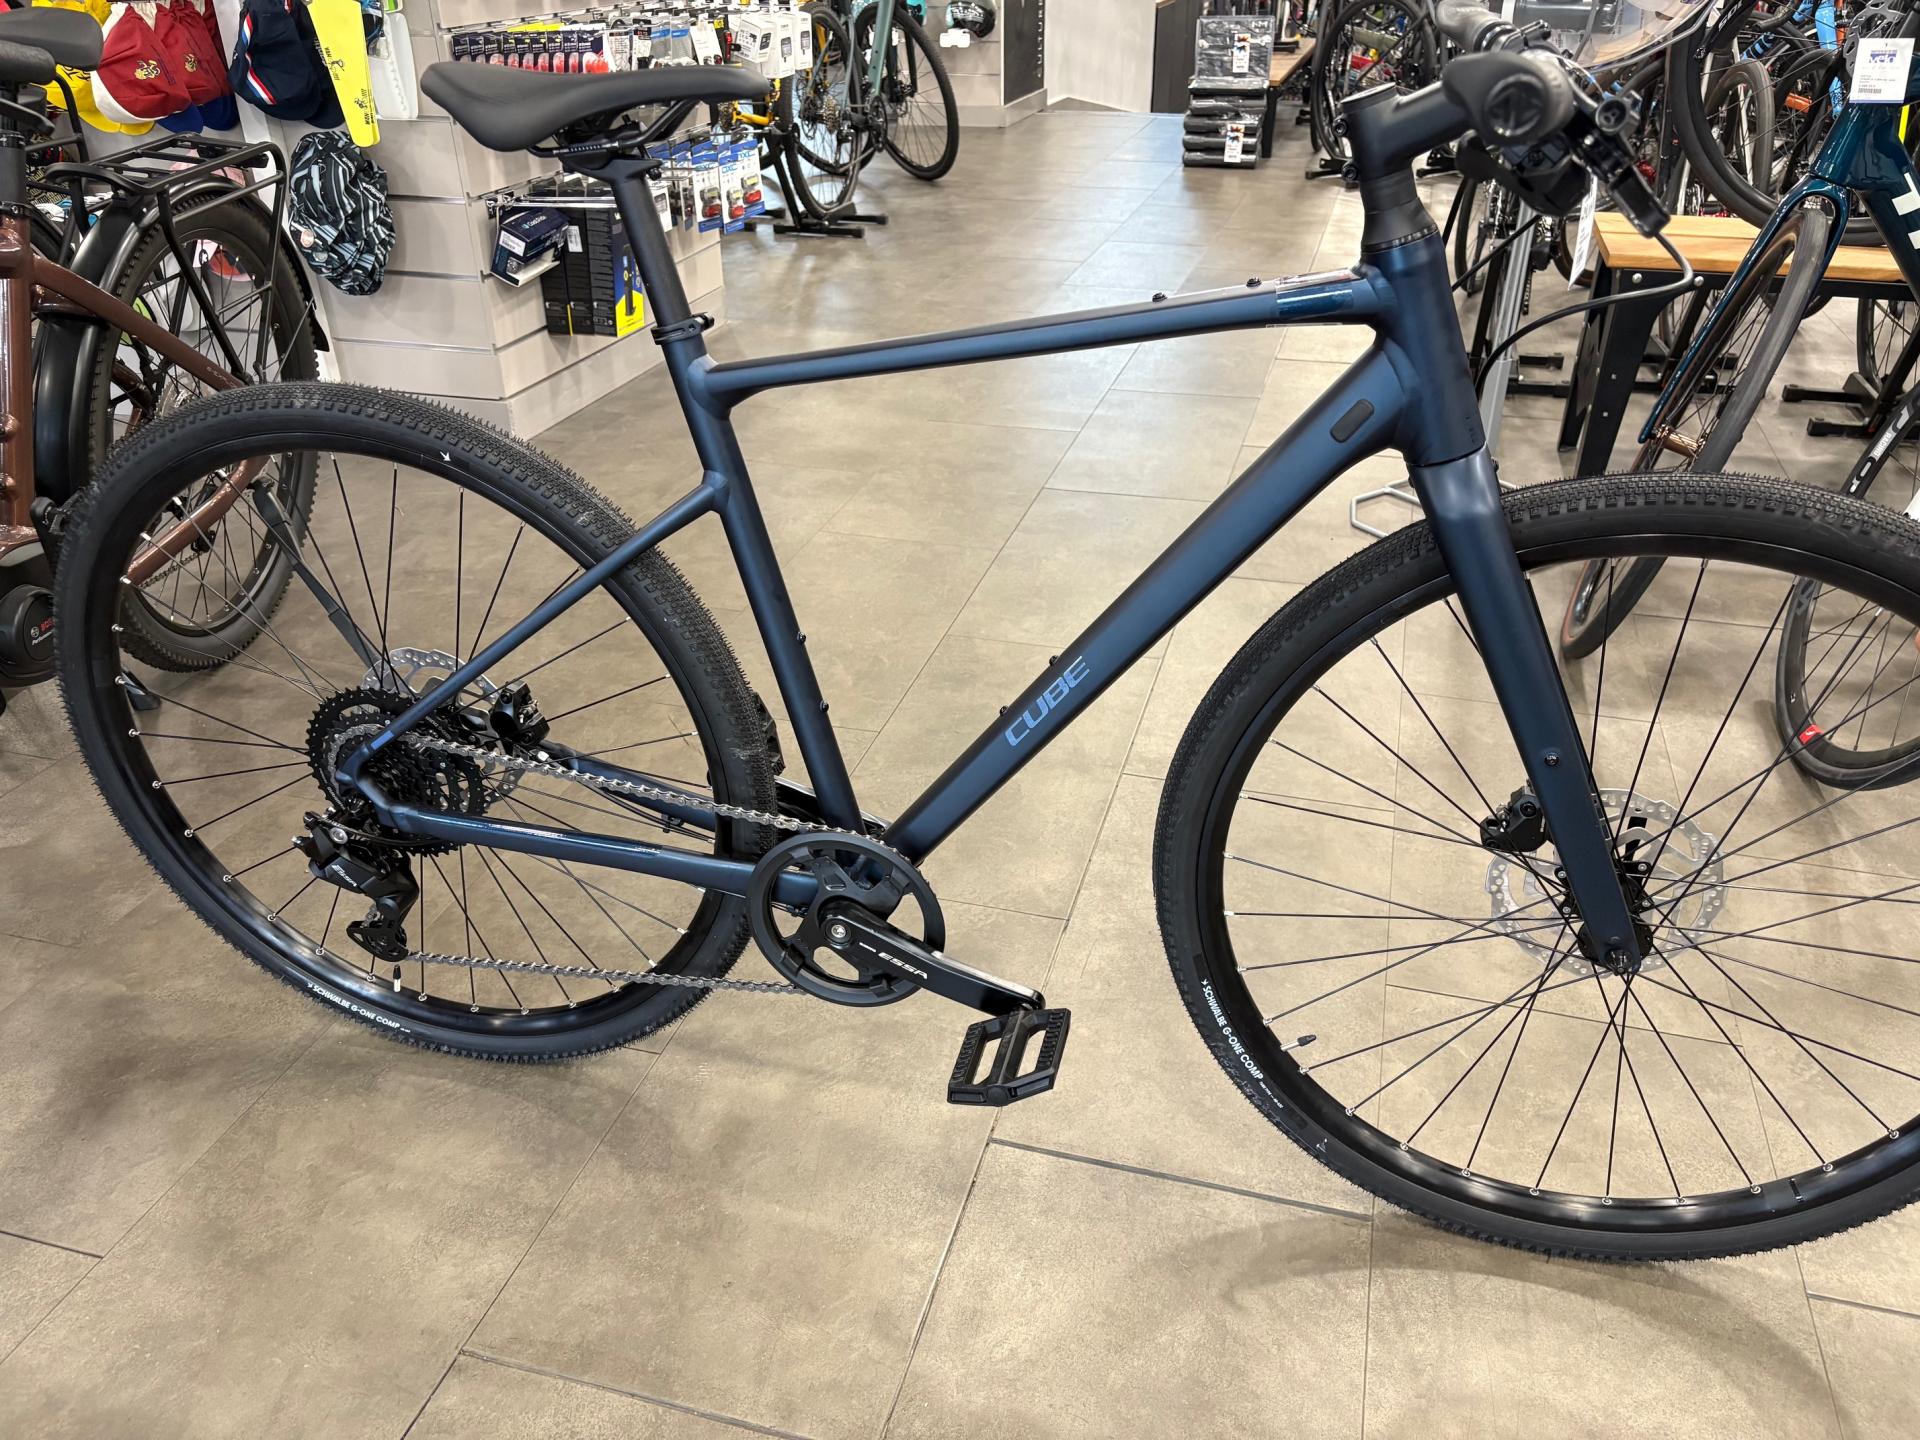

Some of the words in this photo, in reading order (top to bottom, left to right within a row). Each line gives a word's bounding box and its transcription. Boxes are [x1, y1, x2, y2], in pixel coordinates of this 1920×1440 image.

[1005, 656, 1089, 746] CUBE
[878, 952, 928, 979] ESSA
[313, 985, 350, 1009] SCHWALBE
[350, 1004, 376, 1020] G-ONE
[375, 1015, 400, 1029] COMP
[1203, 985, 1227, 1027] SCHWALBE
[1222, 1026, 1246, 1055] G-ONE
[1240, 1053, 1264, 1080] COMP
